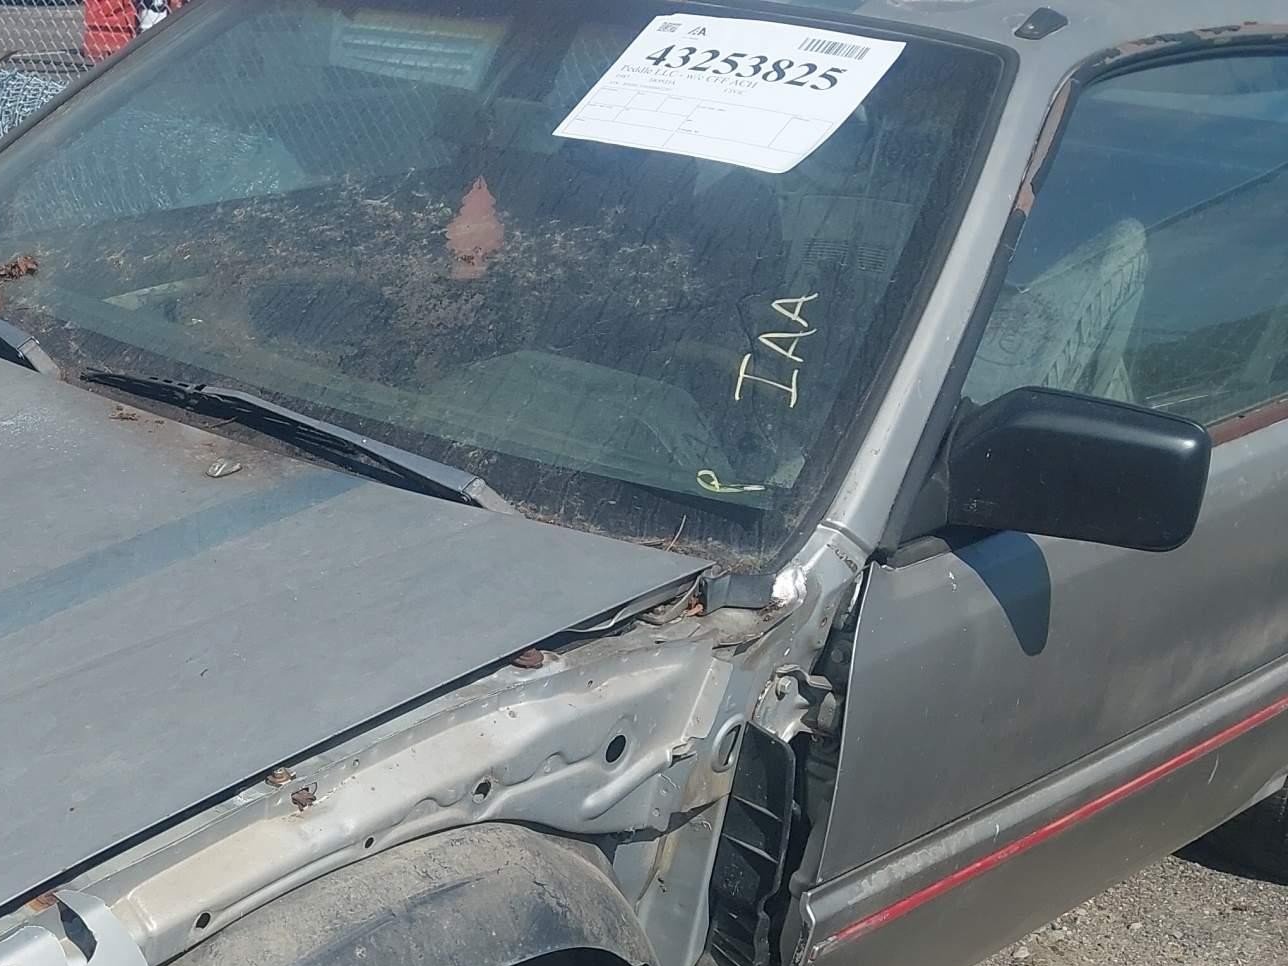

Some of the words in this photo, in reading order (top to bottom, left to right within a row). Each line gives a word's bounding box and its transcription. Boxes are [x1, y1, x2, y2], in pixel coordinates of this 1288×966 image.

[645, 43, 848, 91] 43253825
[654, 67, 679, 77] LLC
[734, 292, 819, 408] IAA
